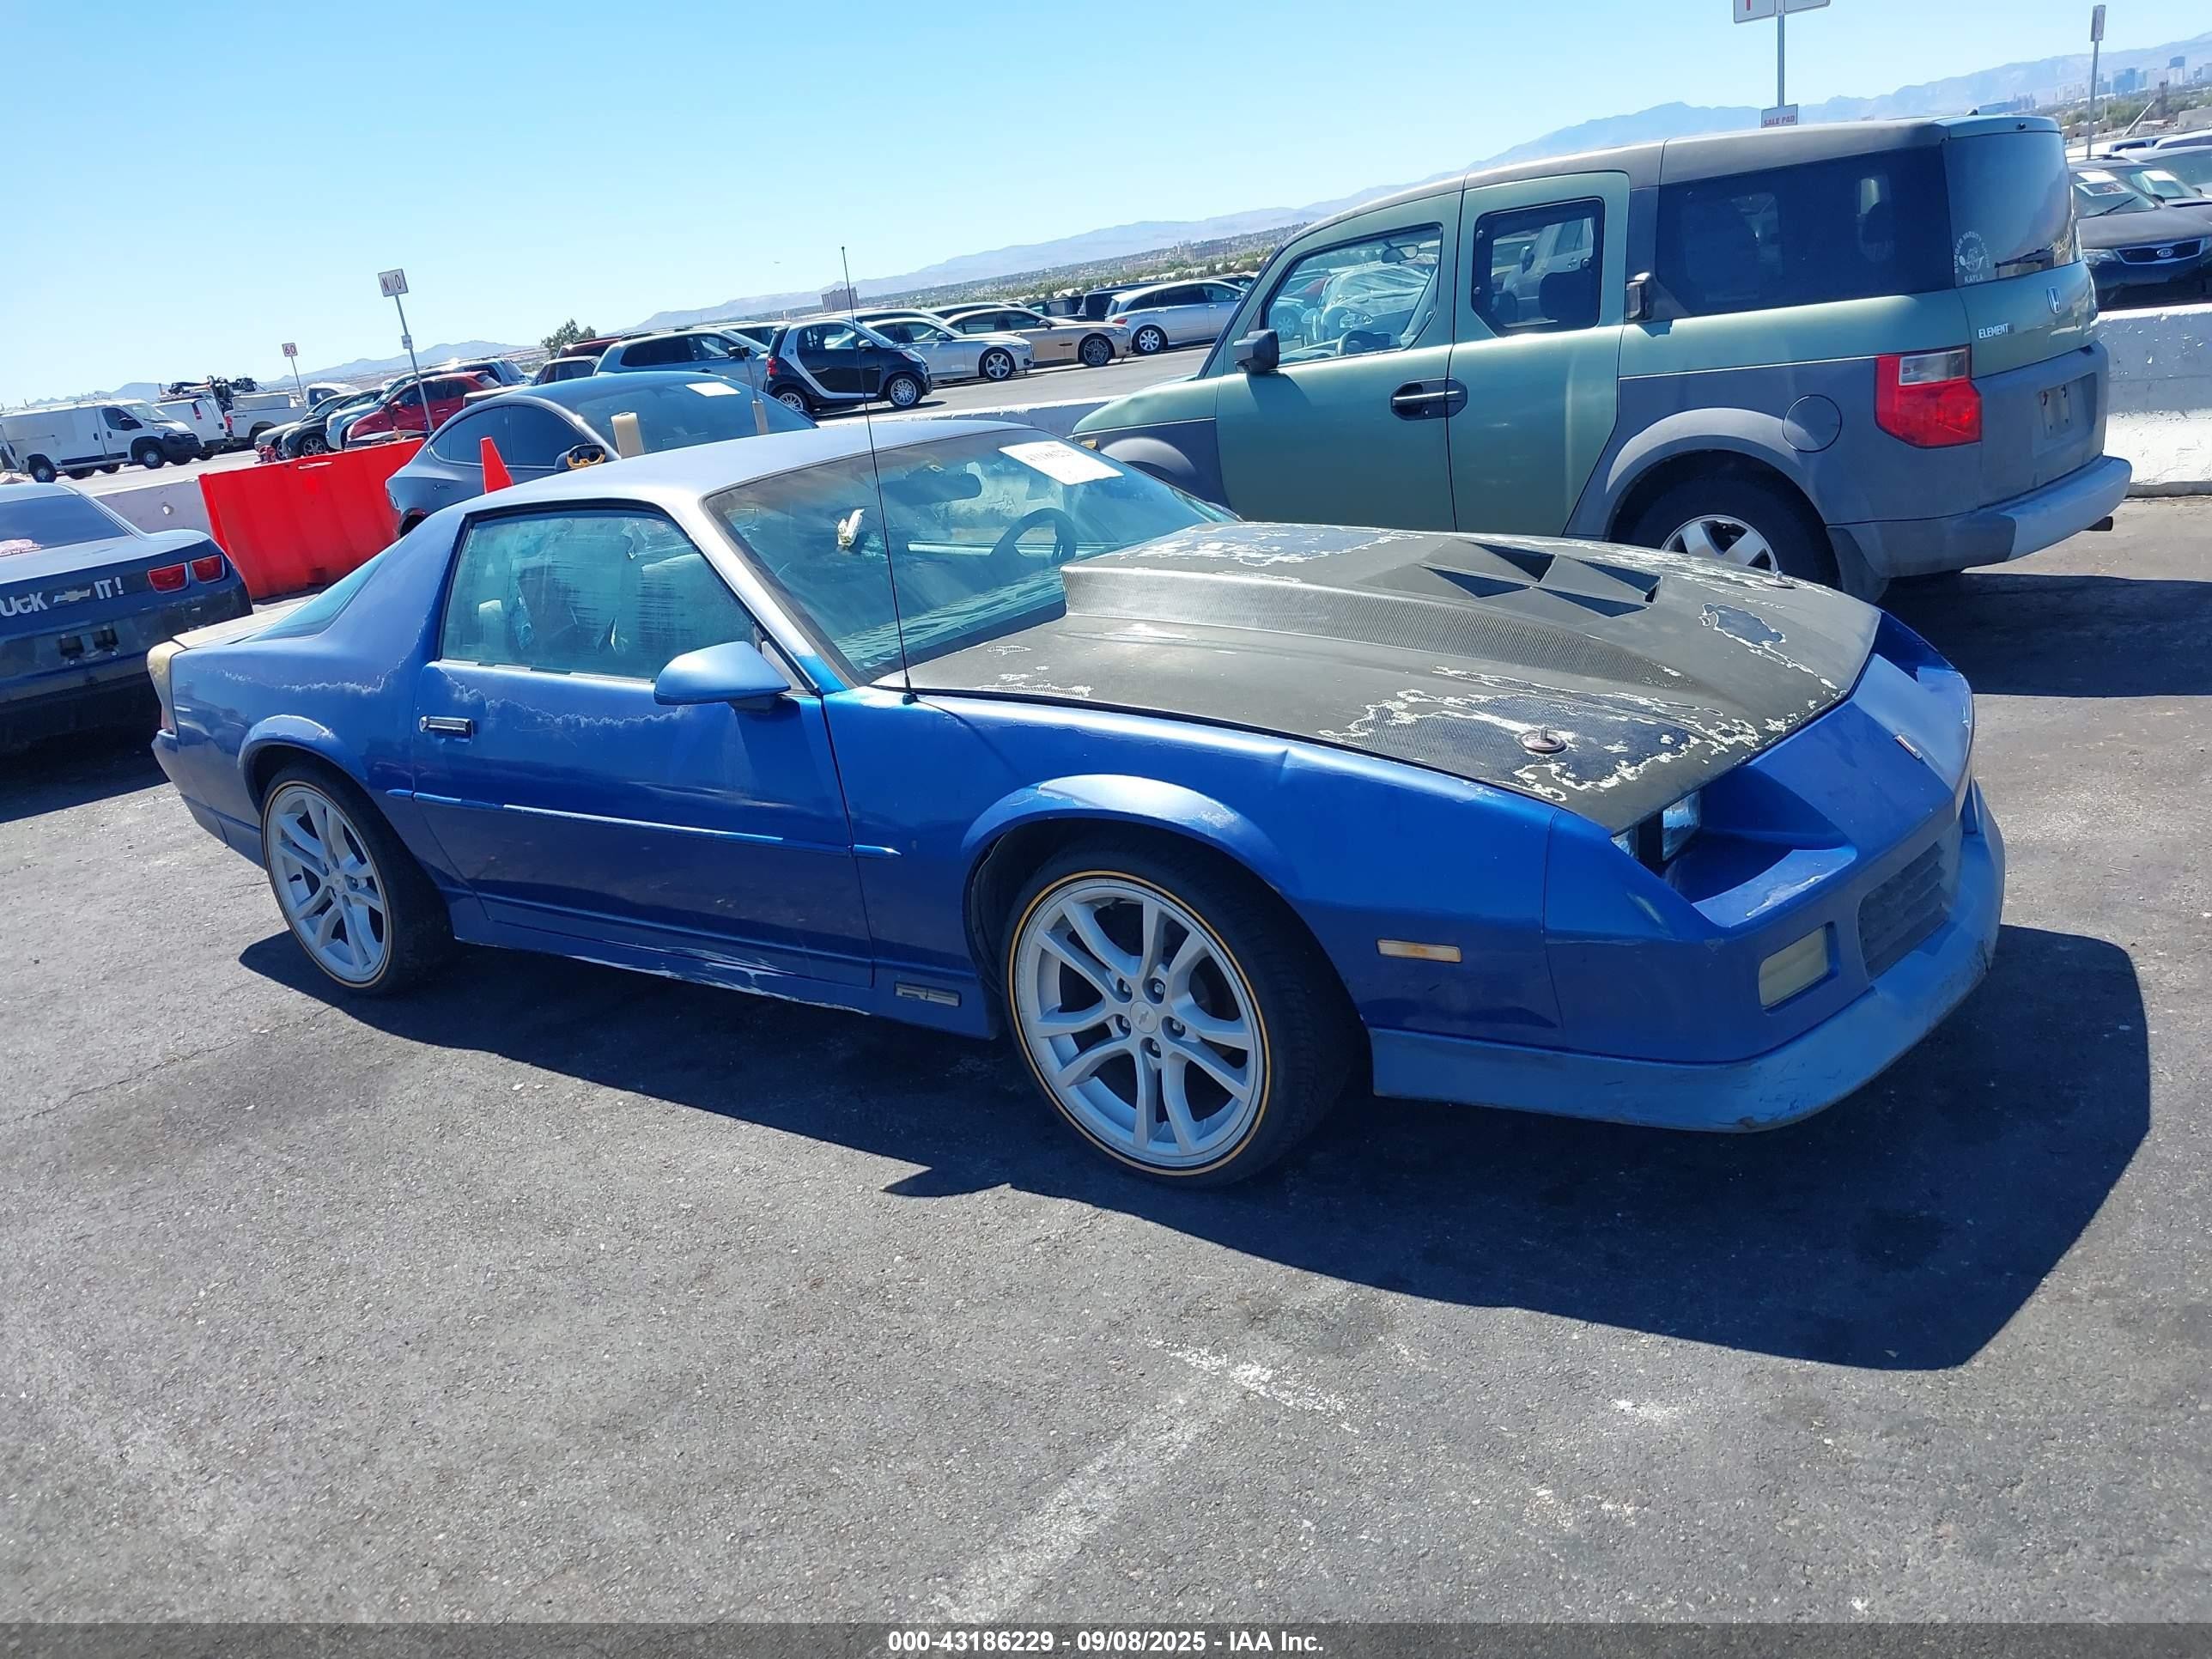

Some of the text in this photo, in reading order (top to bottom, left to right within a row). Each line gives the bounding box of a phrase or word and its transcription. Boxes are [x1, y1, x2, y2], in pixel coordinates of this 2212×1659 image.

[1764, 115, 1796, 125] SALE PAD
[1964, 273, 1984, 283] KAYLA
[1978, 322, 2009, 340] ELEMENT
[284, 344, 296, 355] 60
[94, 576, 125, 600] IT!
